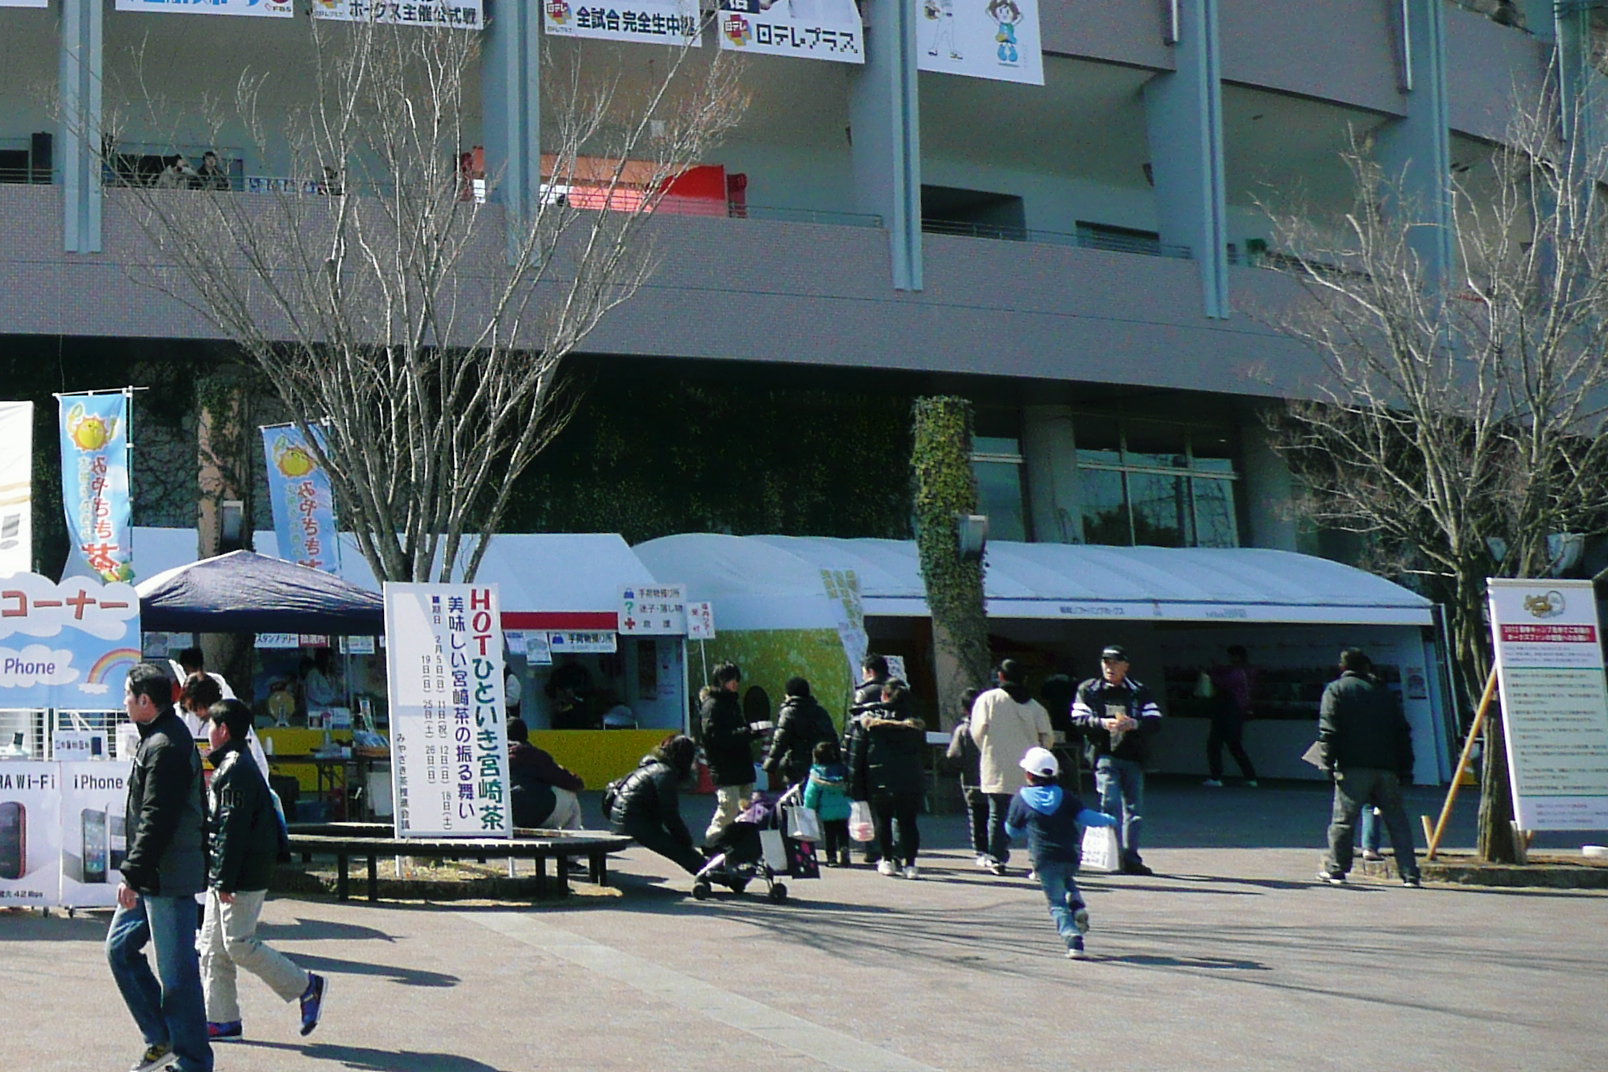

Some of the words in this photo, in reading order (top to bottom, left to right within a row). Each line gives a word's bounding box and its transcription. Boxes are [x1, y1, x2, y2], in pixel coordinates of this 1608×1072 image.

[547, 1, 569, 14] 日テレ
[577, 6, 620, 32] 全試合
[724, 19, 747, 32] 日テレ
[756, 23, 859, 54] 日テレプラス
[447, 595, 476, 820] 美味しい宮崎茶の振る舞い
[16, 774, 56, 790] Wi-Fi
